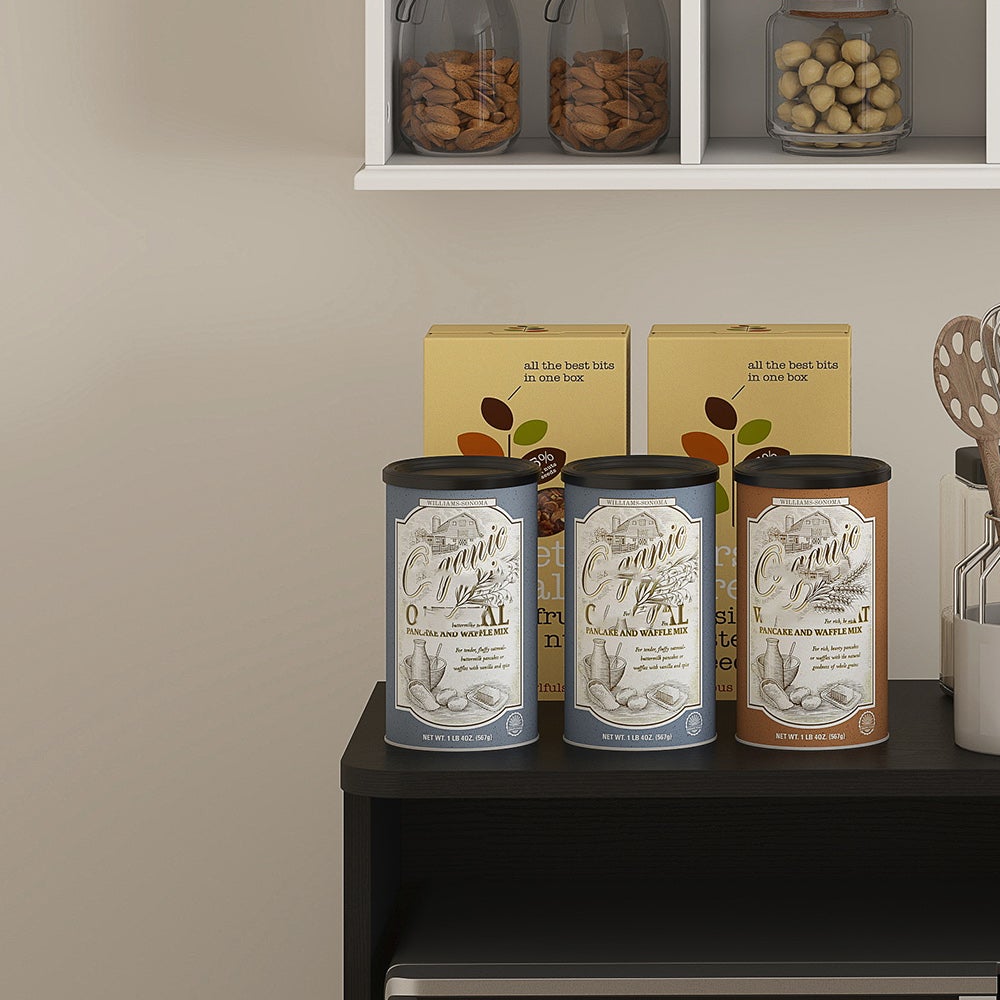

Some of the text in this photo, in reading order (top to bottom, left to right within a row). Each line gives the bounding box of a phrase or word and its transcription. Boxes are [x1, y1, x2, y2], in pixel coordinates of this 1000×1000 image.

[523, 360, 615, 370] all the best bits
[747, 360, 839, 370] all the best bits
[523, 373, 585, 382] in one box
[747, 372, 809, 382] in one box
[493, 627, 509, 635] MIX
[585, 626, 688, 637] PANCAKE AND WAFFLE MIX
[759, 626, 863, 637] PANCAKE AND WAFFLE MIX
[475, 733, 493, 741] (567g)
[655, 733, 673, 741] (567g)
[828, 732, 846, 740] (567g)
